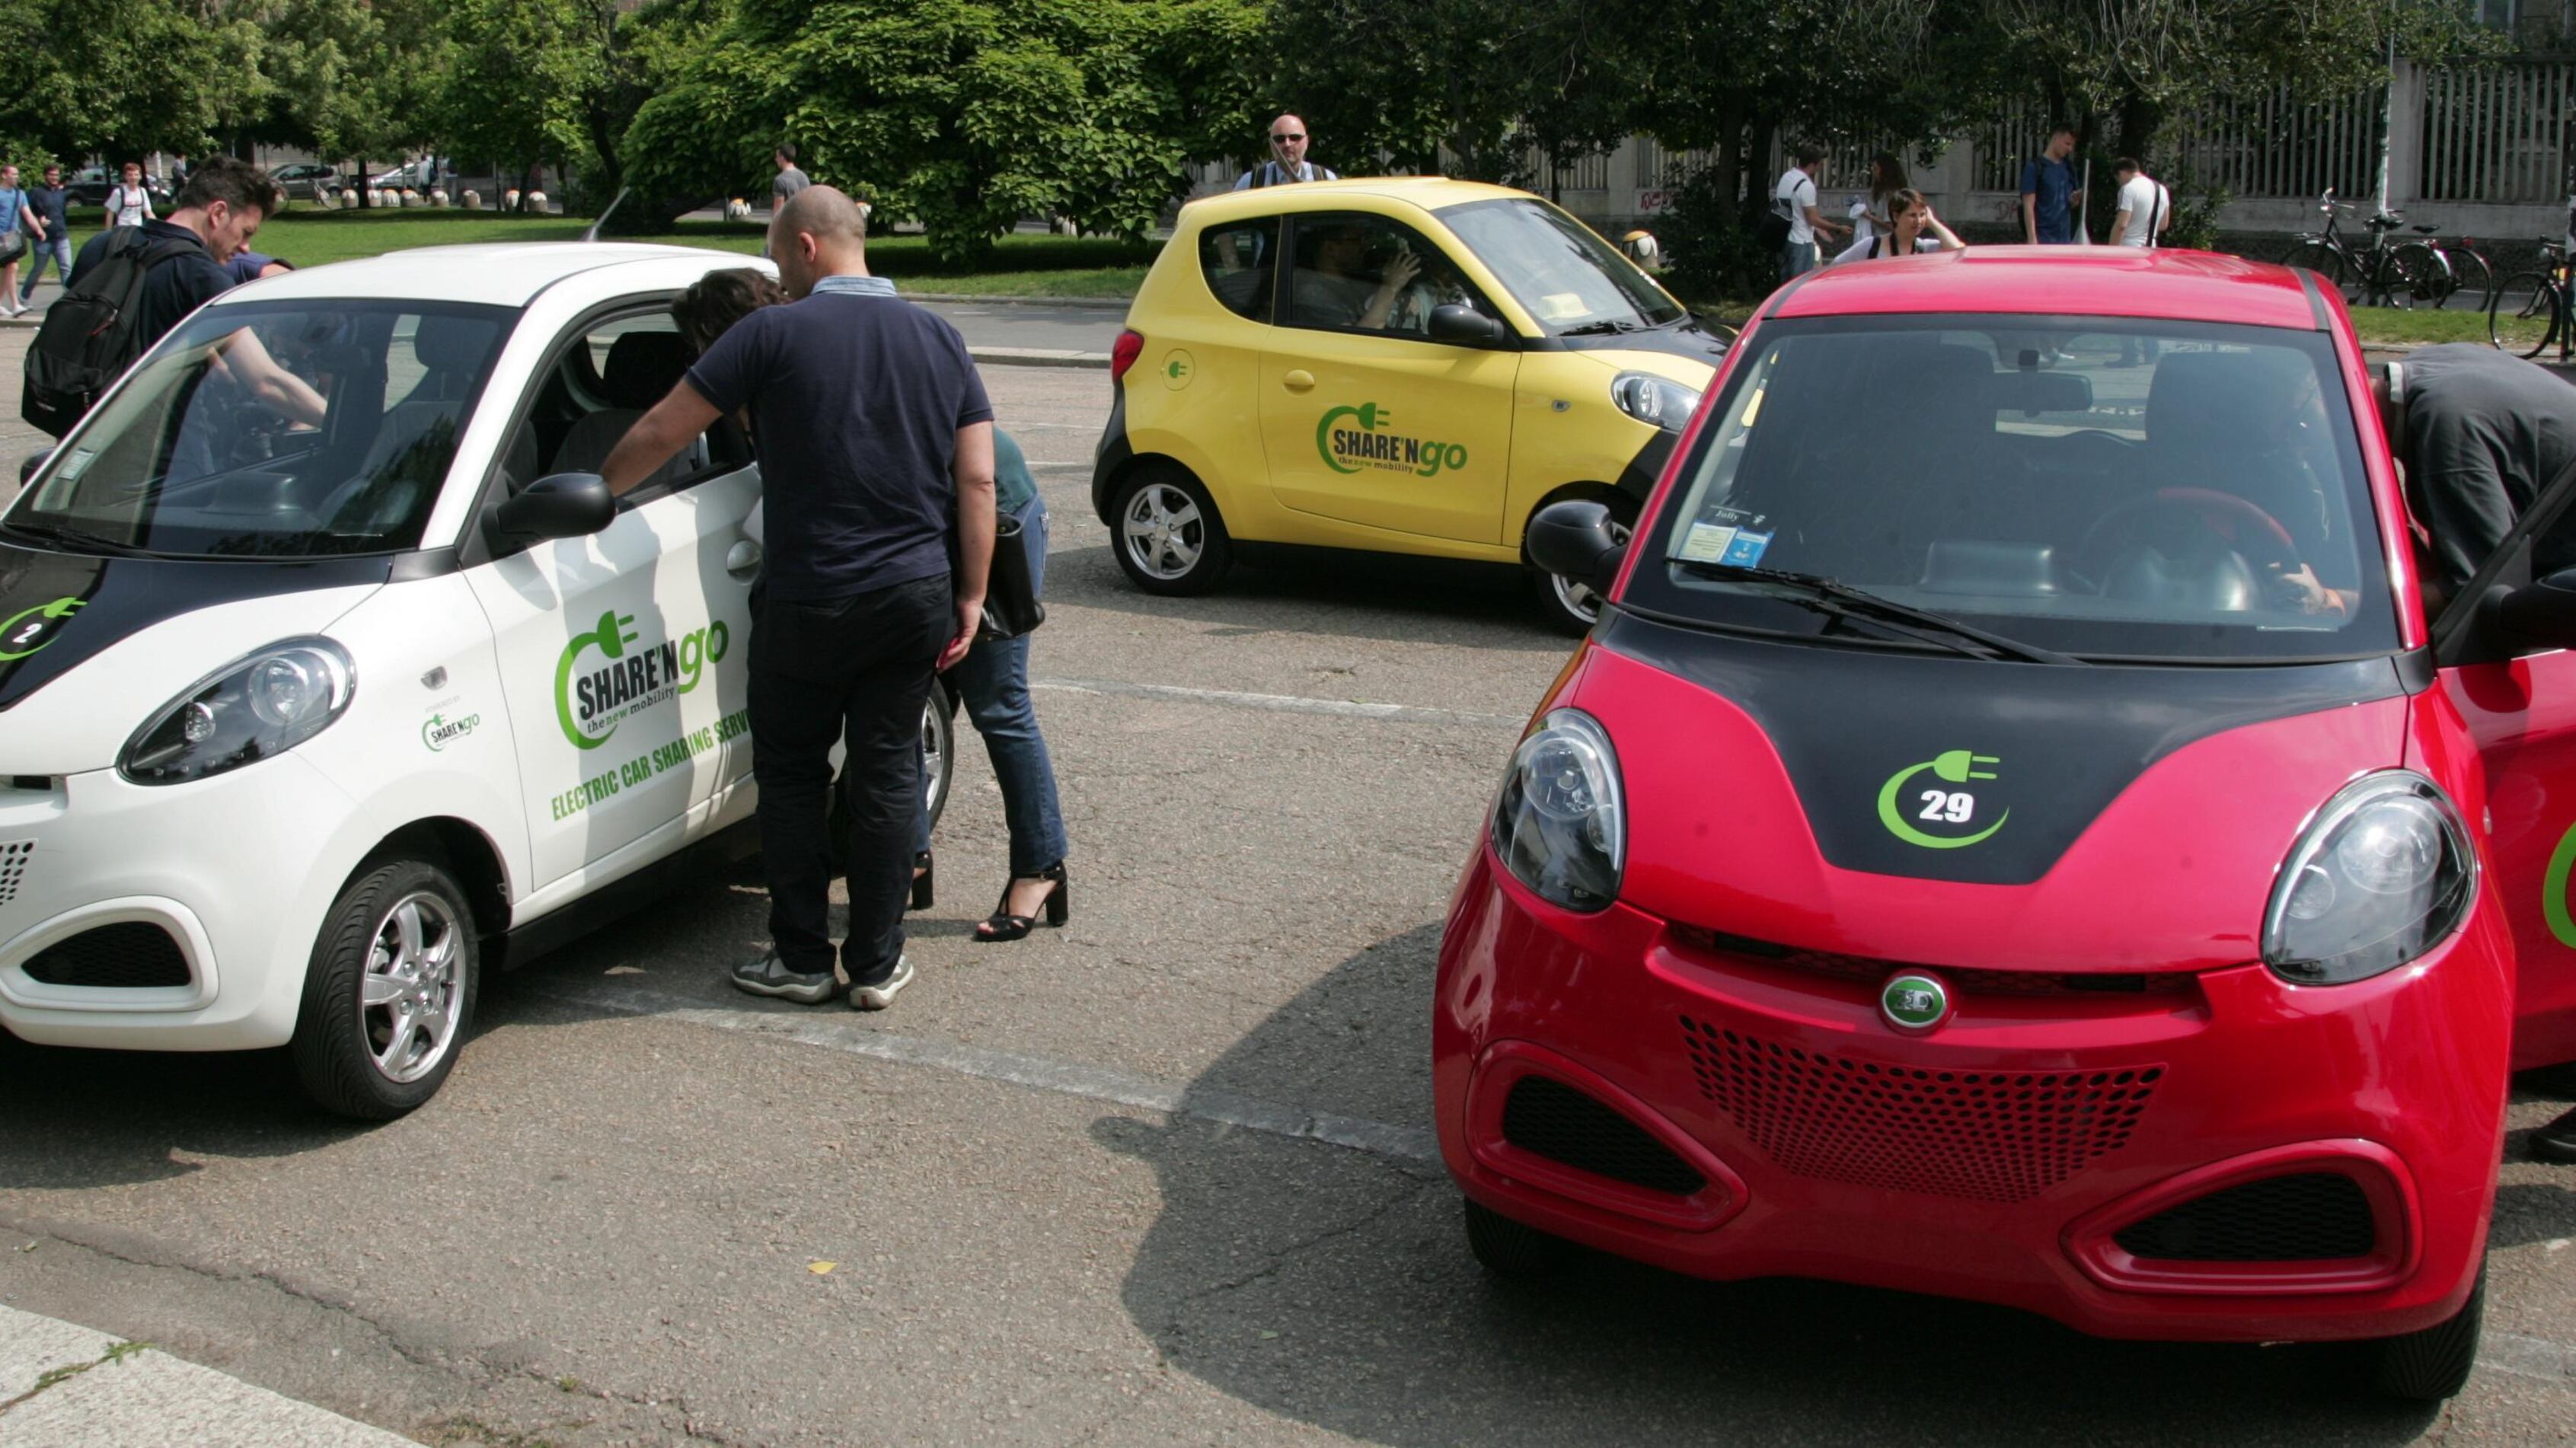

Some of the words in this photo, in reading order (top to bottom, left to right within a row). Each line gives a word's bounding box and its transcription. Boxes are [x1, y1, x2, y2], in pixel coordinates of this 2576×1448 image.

[1374, 462, 1414, 474] mobility
[12, 623, 43, 643] 2
[587, 719, 605, 733] the
[606, 708, 628, 726] new
[629, 687, 675, 714] mobility
[551, 770, 620, 821] ELECTRIC
[621, 755, 653, 788] CAR
[652, 726, 714, 773] SHARING
[1919, 789, 1974, 823] 29
